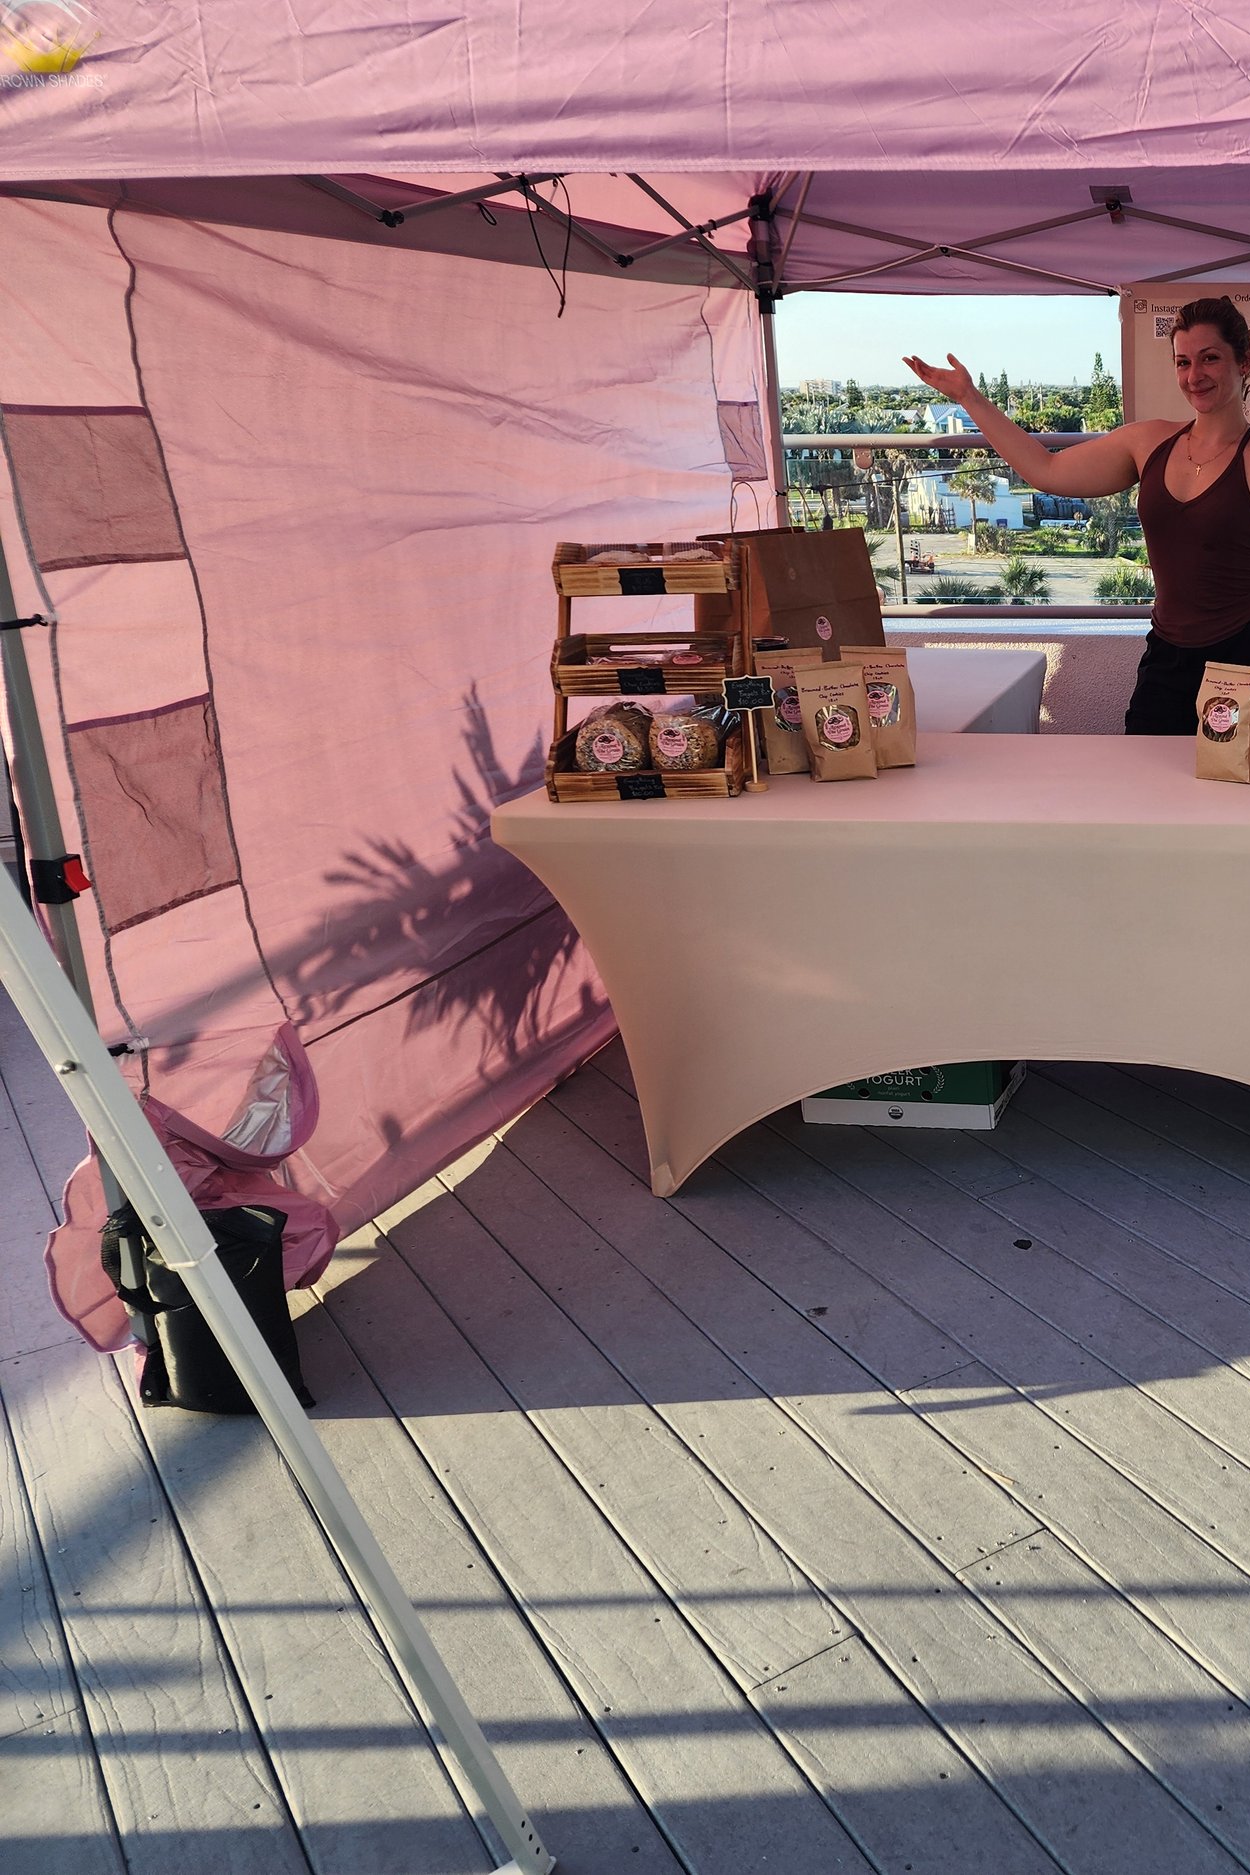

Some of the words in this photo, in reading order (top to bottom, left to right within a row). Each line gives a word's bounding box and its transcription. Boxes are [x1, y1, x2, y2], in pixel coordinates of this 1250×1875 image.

[0, 74, 46, 89] ROWN
[49, 74, 104, 88] SHADES
[1151, 303, 1183, 314] Instagr
[865, 1075, 923, 1086] YOGURT
